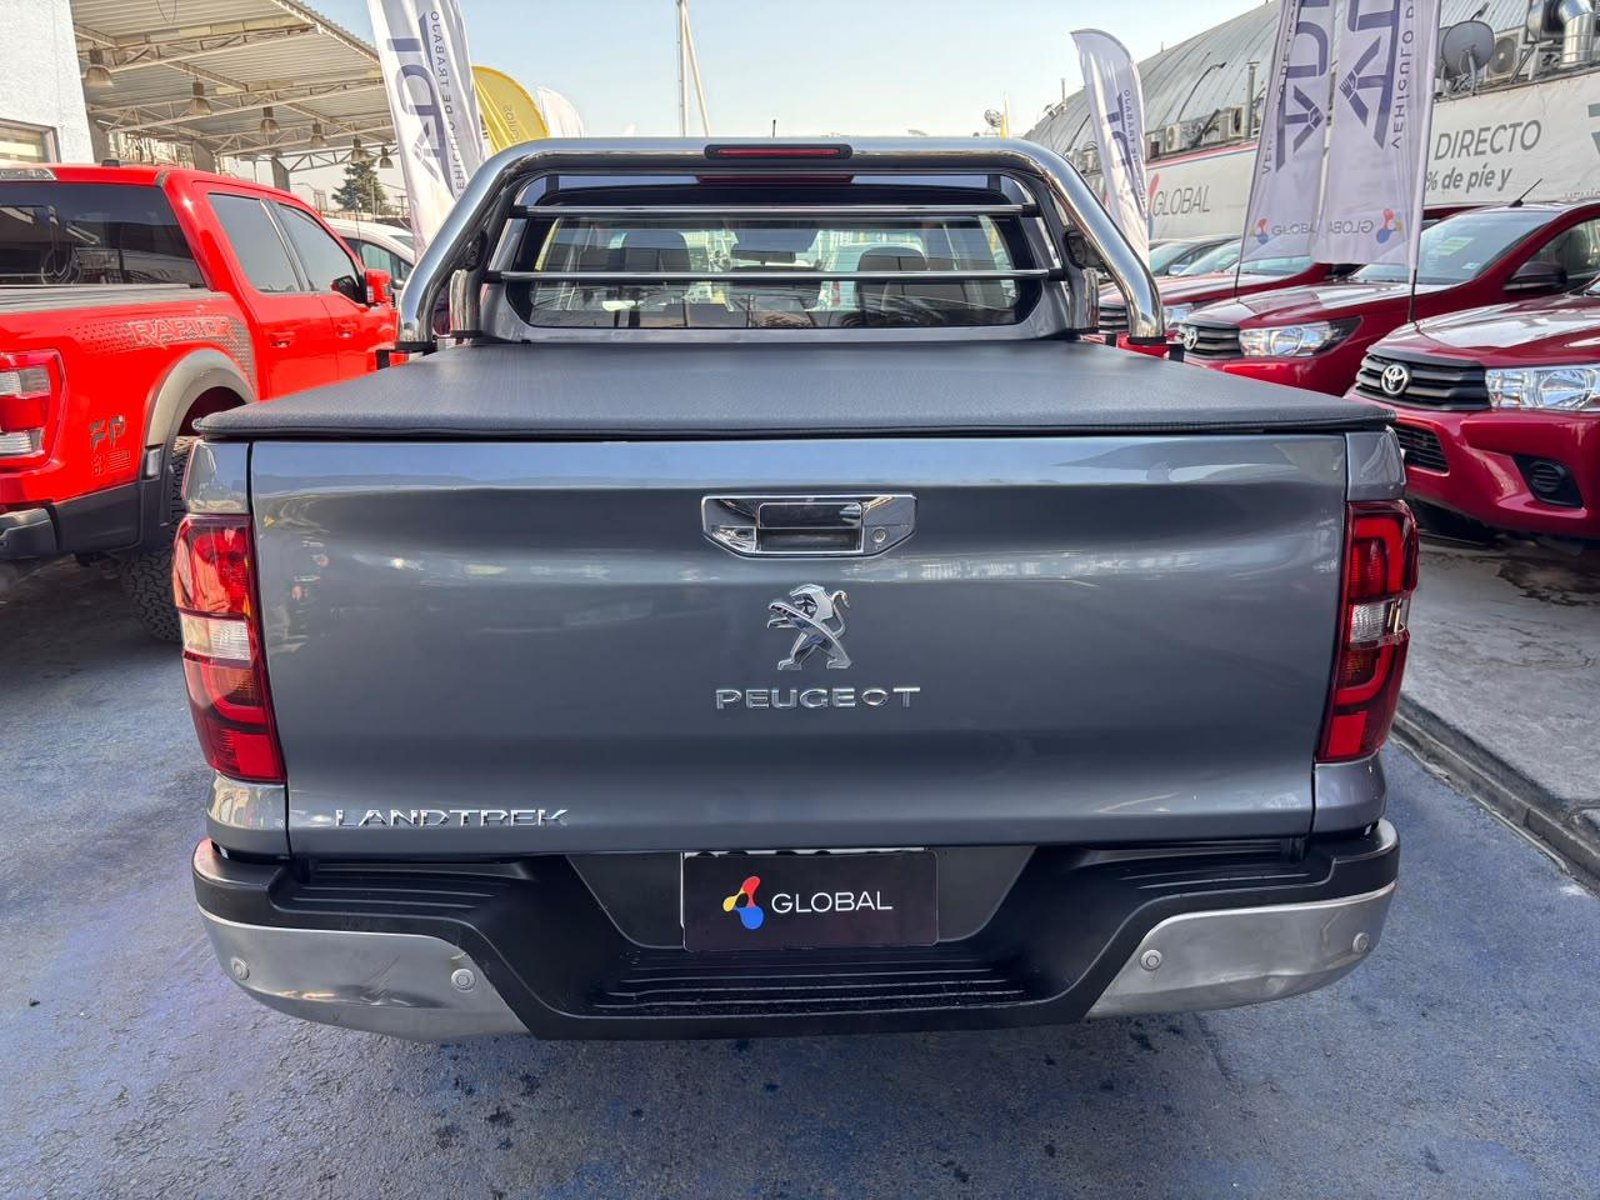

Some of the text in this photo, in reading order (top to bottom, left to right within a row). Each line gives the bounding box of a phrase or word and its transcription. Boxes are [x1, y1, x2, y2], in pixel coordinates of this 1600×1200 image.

[1434, 120, 1542, 161] DIRECTO
[1442, 166, 1464, 190] de
[1497, 168, 1513, 192] y
[1152, 185, 1211, 217] GLOBAL
[715, 686, 921, 710] PEUGEOT
[335, 808, 569, 828] LANDTREK
[770, 890, 893, 914] GLOBAL
